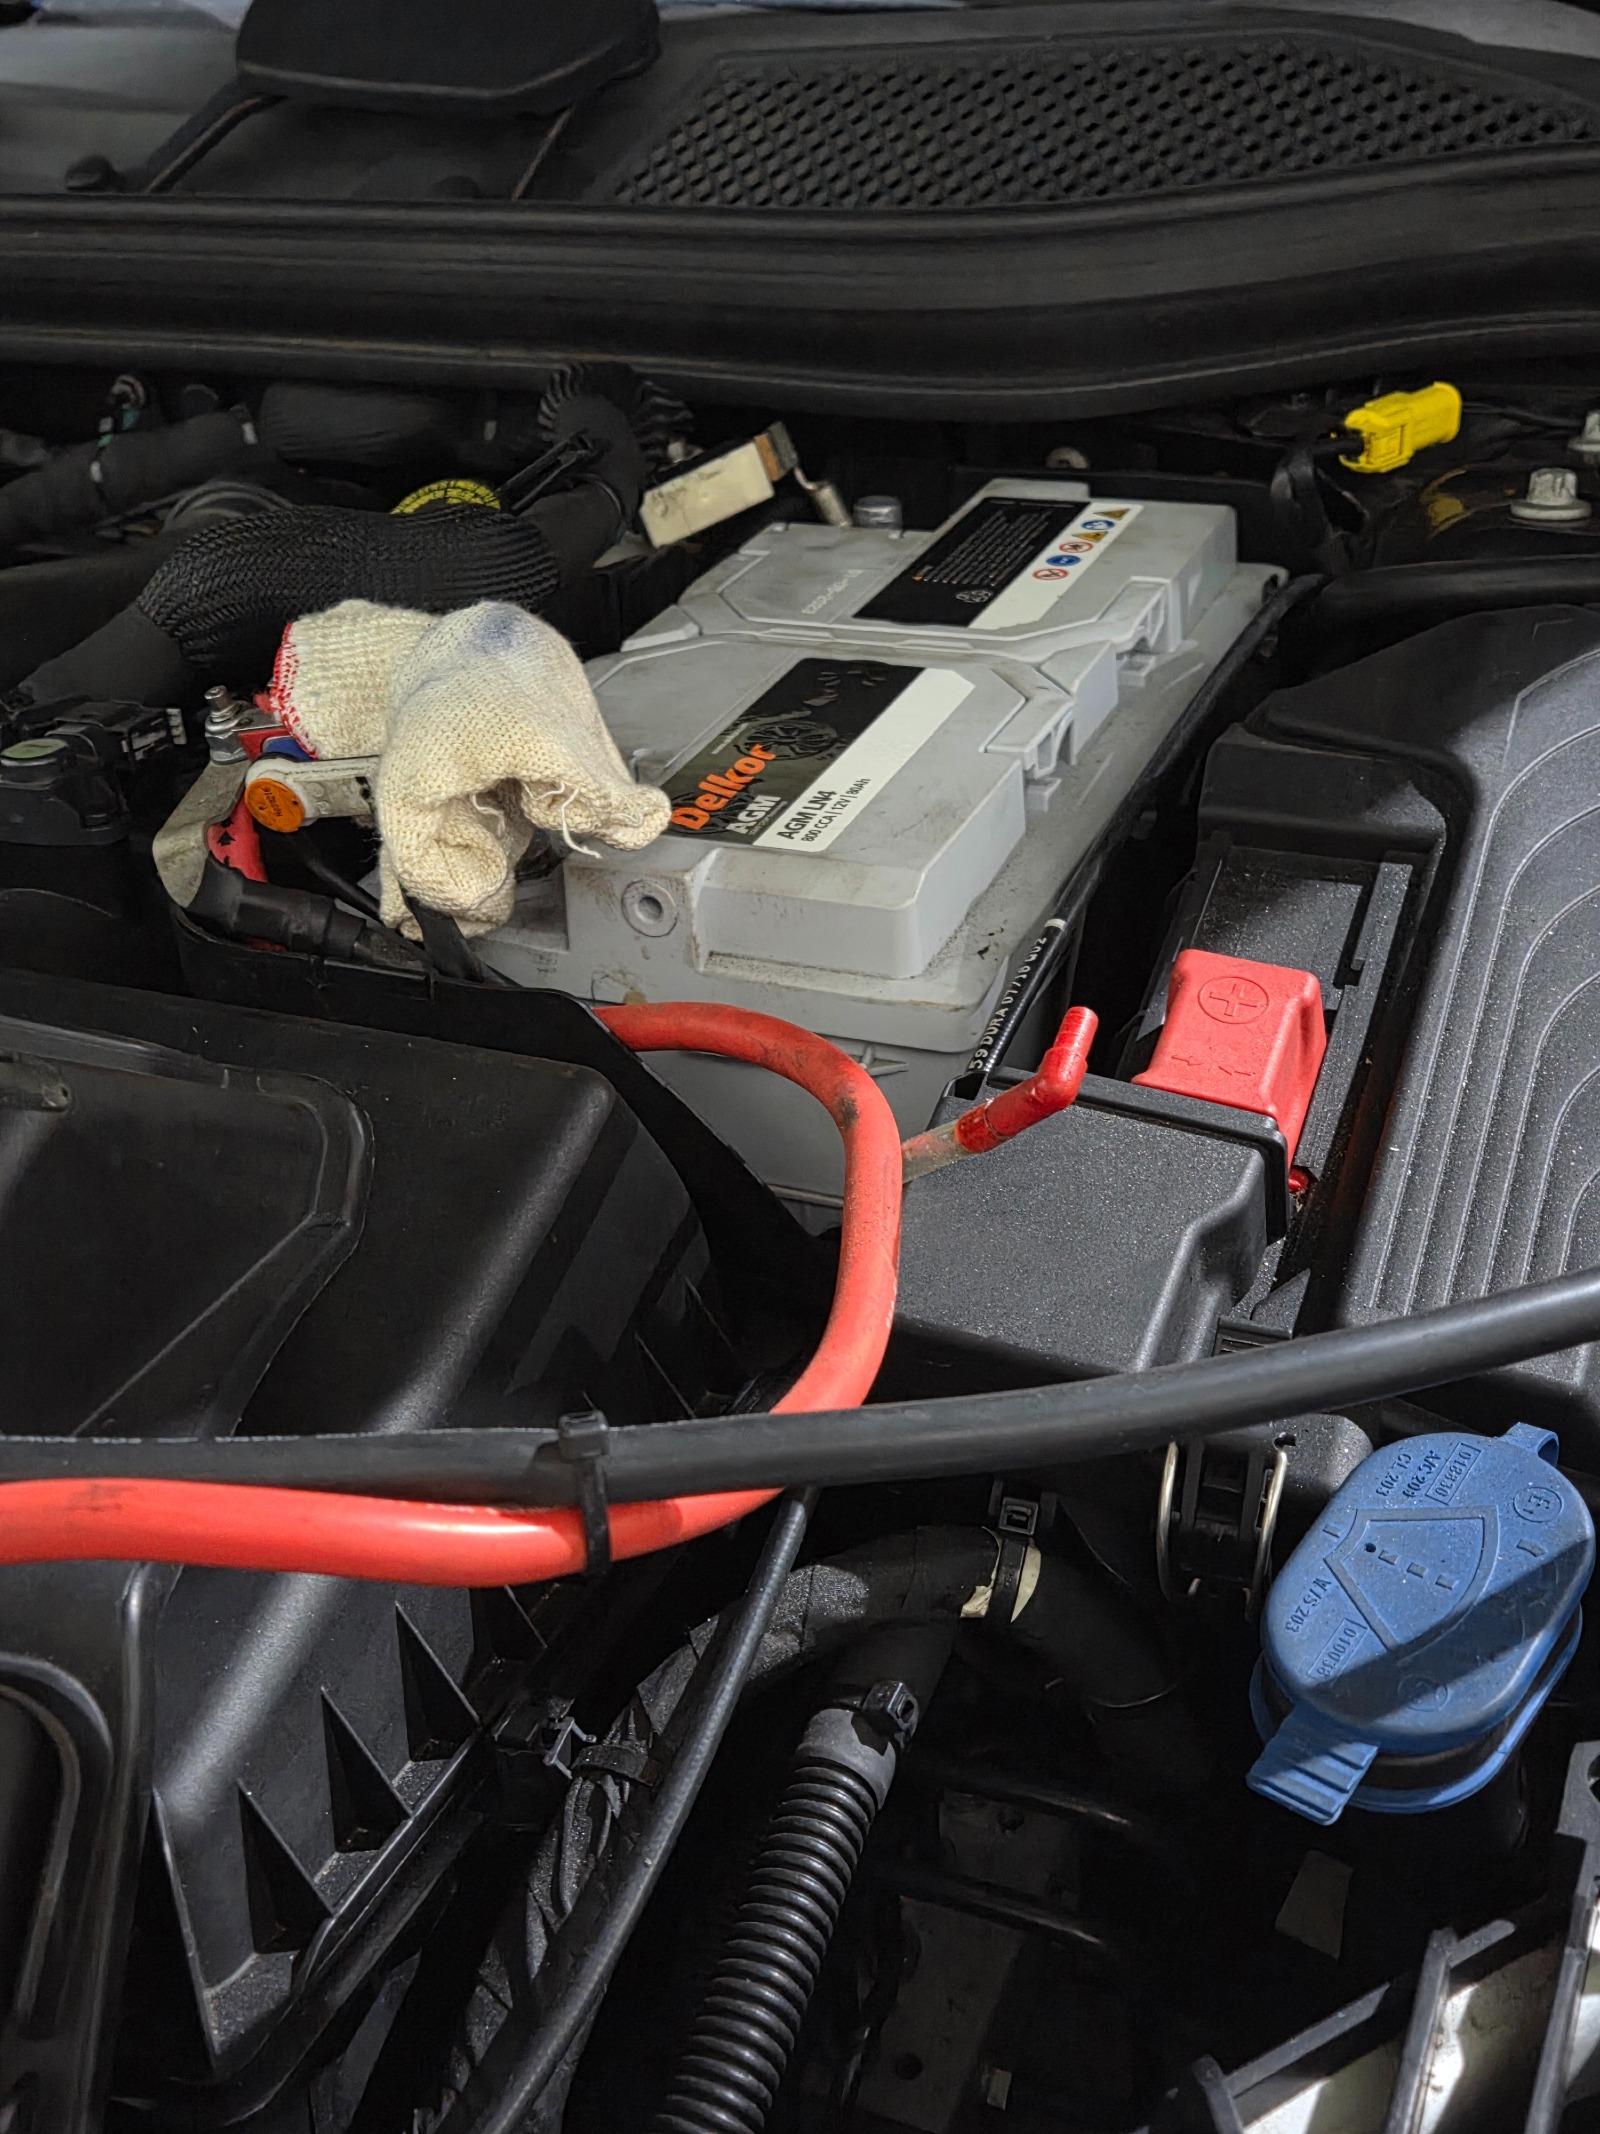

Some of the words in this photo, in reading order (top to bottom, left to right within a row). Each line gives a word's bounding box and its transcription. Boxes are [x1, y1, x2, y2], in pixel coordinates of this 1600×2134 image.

[671, 743, 776, 830] Delkor
[726, 794, 782, 834] AGM
[776, 811, 818, 840] AGM
[802, 790, 837, 810] LN4
[801, 829, 822, 842] 800
[814, 815, 837, 829] CCA
[831, 798, 851, 810] 12V
[980, 1007, 1009, 1046] DURA
[1391, 1453, 1412, 1470] CL
[1285, 1605, 1310, 1633] 203
